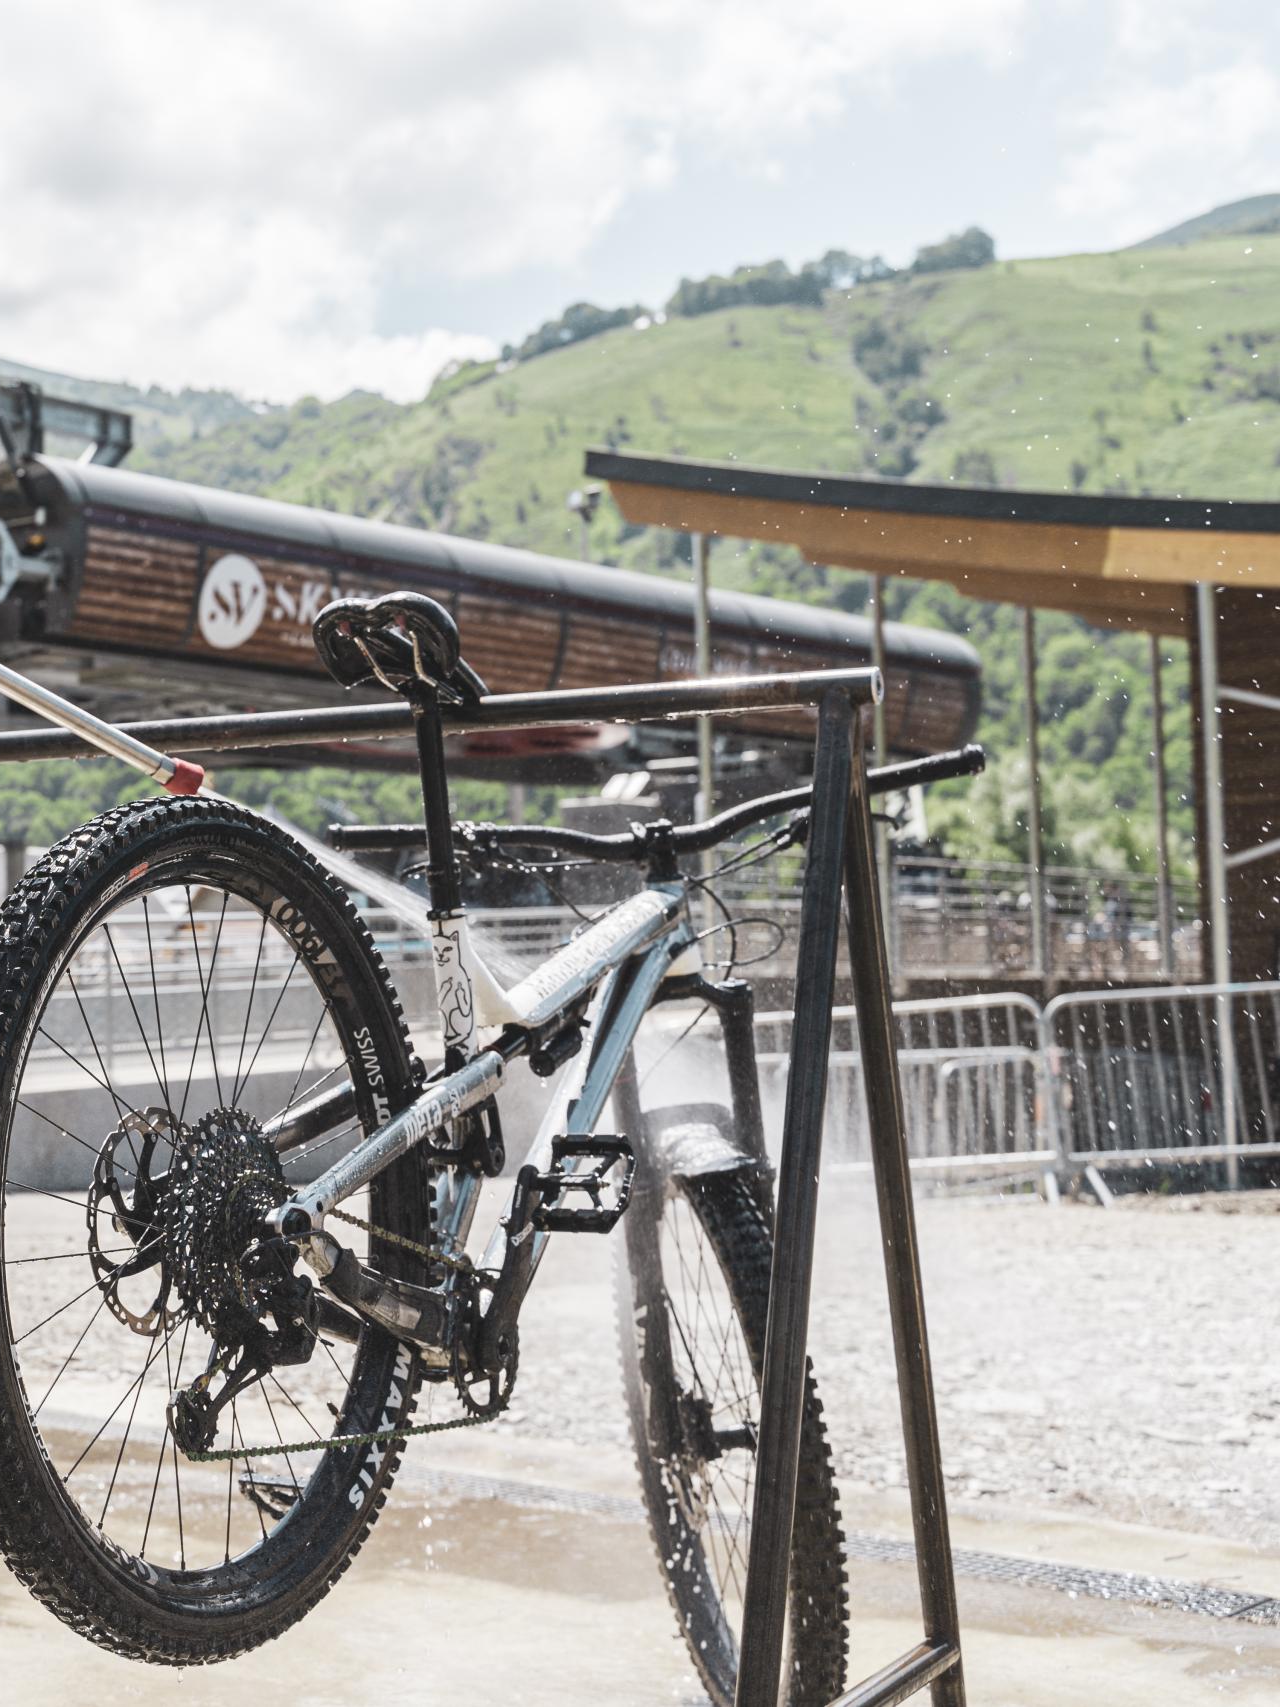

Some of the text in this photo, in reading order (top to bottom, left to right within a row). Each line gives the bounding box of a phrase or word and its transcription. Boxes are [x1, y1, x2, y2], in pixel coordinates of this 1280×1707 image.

[353, 1026, 393, 1126] DT SWISS
[348, 1341, 413, 1511] MAXXIS
